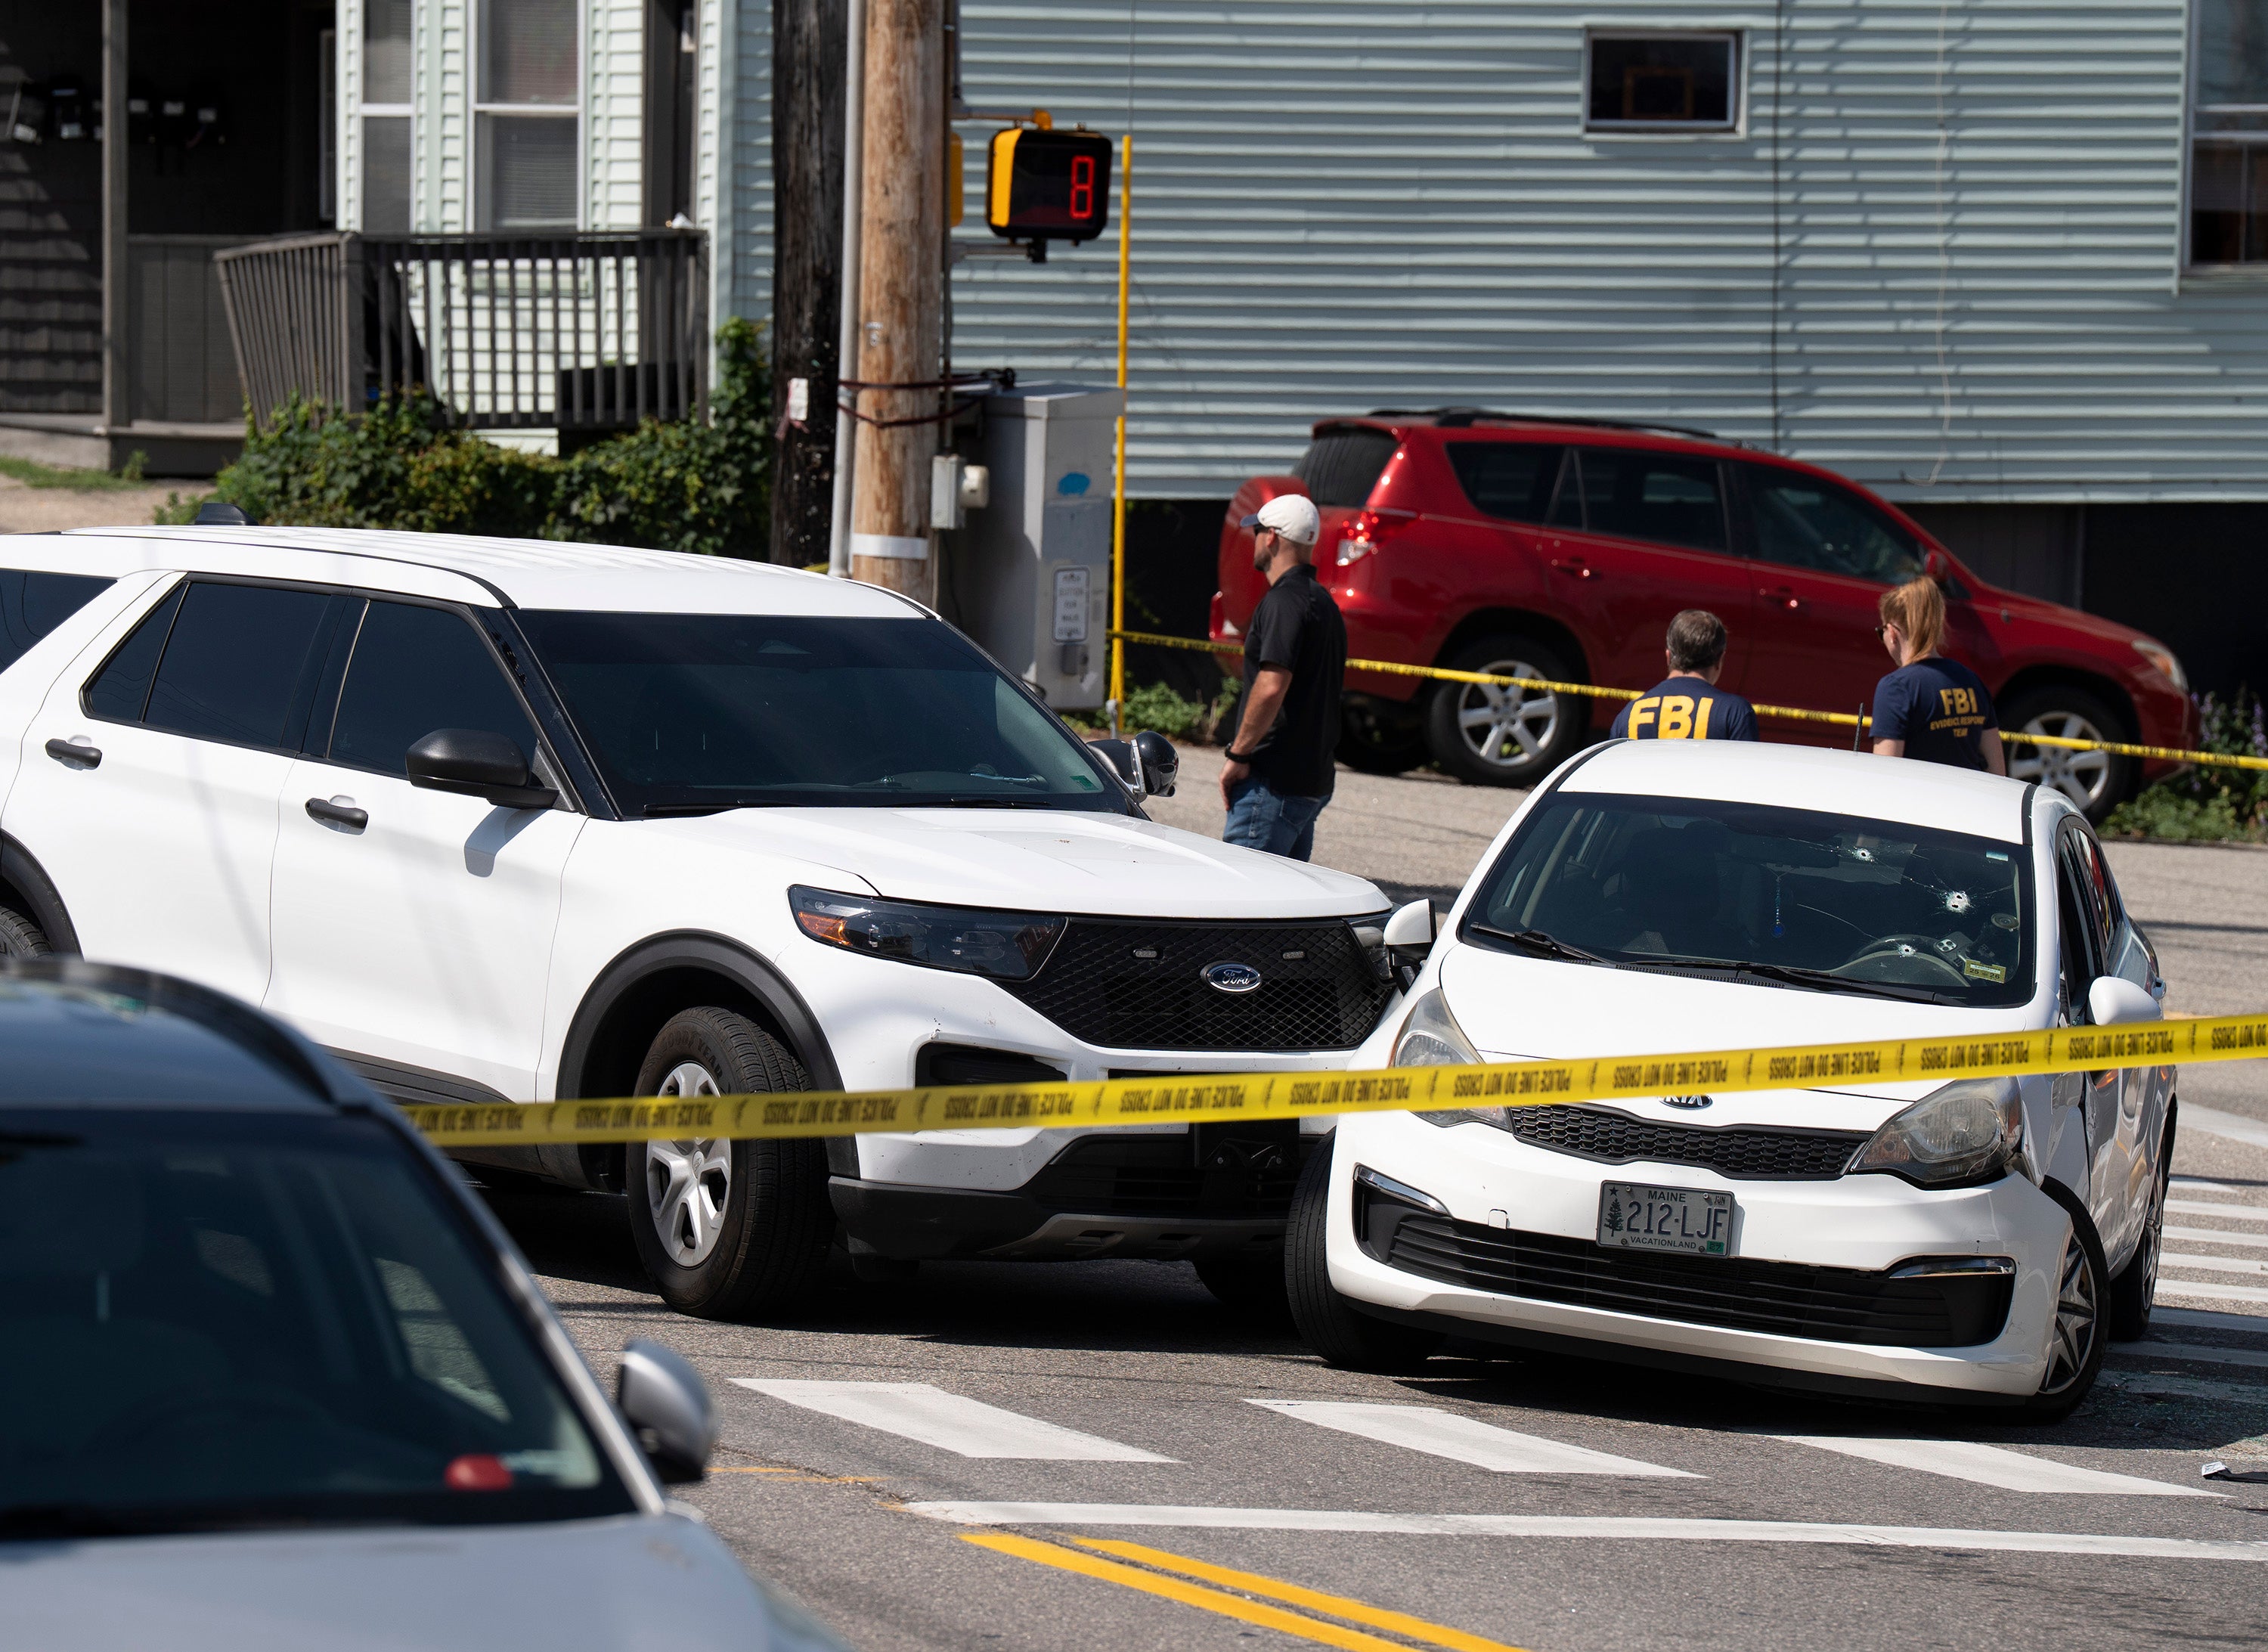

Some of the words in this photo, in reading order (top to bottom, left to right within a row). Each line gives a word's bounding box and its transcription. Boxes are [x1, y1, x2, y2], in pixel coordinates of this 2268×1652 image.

[1070, 155, 1095, 219] 8
[1940, 688, 1978, 715] FBI
[1628, 696, 1714, 739] FBI
[1222, 969, 1250, 984] Ford
[2097, 1035, 2112, 1058] NOT
[2115, 1034, 2125, 1058] DO
[2127, 1033, 2145, 1056] LINE
[2146, 1031, 2174, 1055] POLICE
[2211, 1025, 2237, 1050] CROSS
[2239, 1024, 2254, 1048] NOT
[2256, 1023, 2267, 1046] DO
[1920, 1046, 1947, 1071] CROSS
[1949, 1045, 1966, 1069] NOT
[1968, 1044, 1979, 1068] DO
[1981, 1043, 1999, 1067] LINE
[2001, 1041, 2030, 1065] POLICE
[2068, 1037, 2094, 1061] CROSS
[1663, 1063, 1675, 1086] DO
[1678, 1062, 1696, 1086] LINE
[1697, 1060, 1728, 1084] POLICE
[1769, 1056, 1796, 1080] CROSS
[1799, 1055, 1815, 1079] NOT
[1817, 1054, 1829, 1077] DO
[1831, 1052, 1849, 1077] LINE
[1851, 1051, 1881, 1075] POLICE
[1453, 1073, 1482, 1097] CROSS
[1484, 1071, 1502, 1096] NOT
[1504, 1071, 1517, 1094] DO
[1519, 1070, 1538, 1093] LINE
[1541, 1068, 1572, 1093] POLICE
[1613, 1065, 1641, 1089] CROSS
[1643, 1064, 1661, 1088] NOT
[1290, 1080, 1319, 1105] CROSS
[1321, 1080, 1340, 1104] NOT
[1341, 1079, 1355, 1103] DO
[1357, 1078, 1376, 1102] LINE
[1379, 1076, 1411, 1102] POLICE
[1648, 1190, 1686, 1203] MAINE
[1714, 1195, 1726, 1204] JUN
[1626, 1201, 1727, 1240] 212-LJF
[1630, 1236, 1696, 1249] VACATIONLAND
